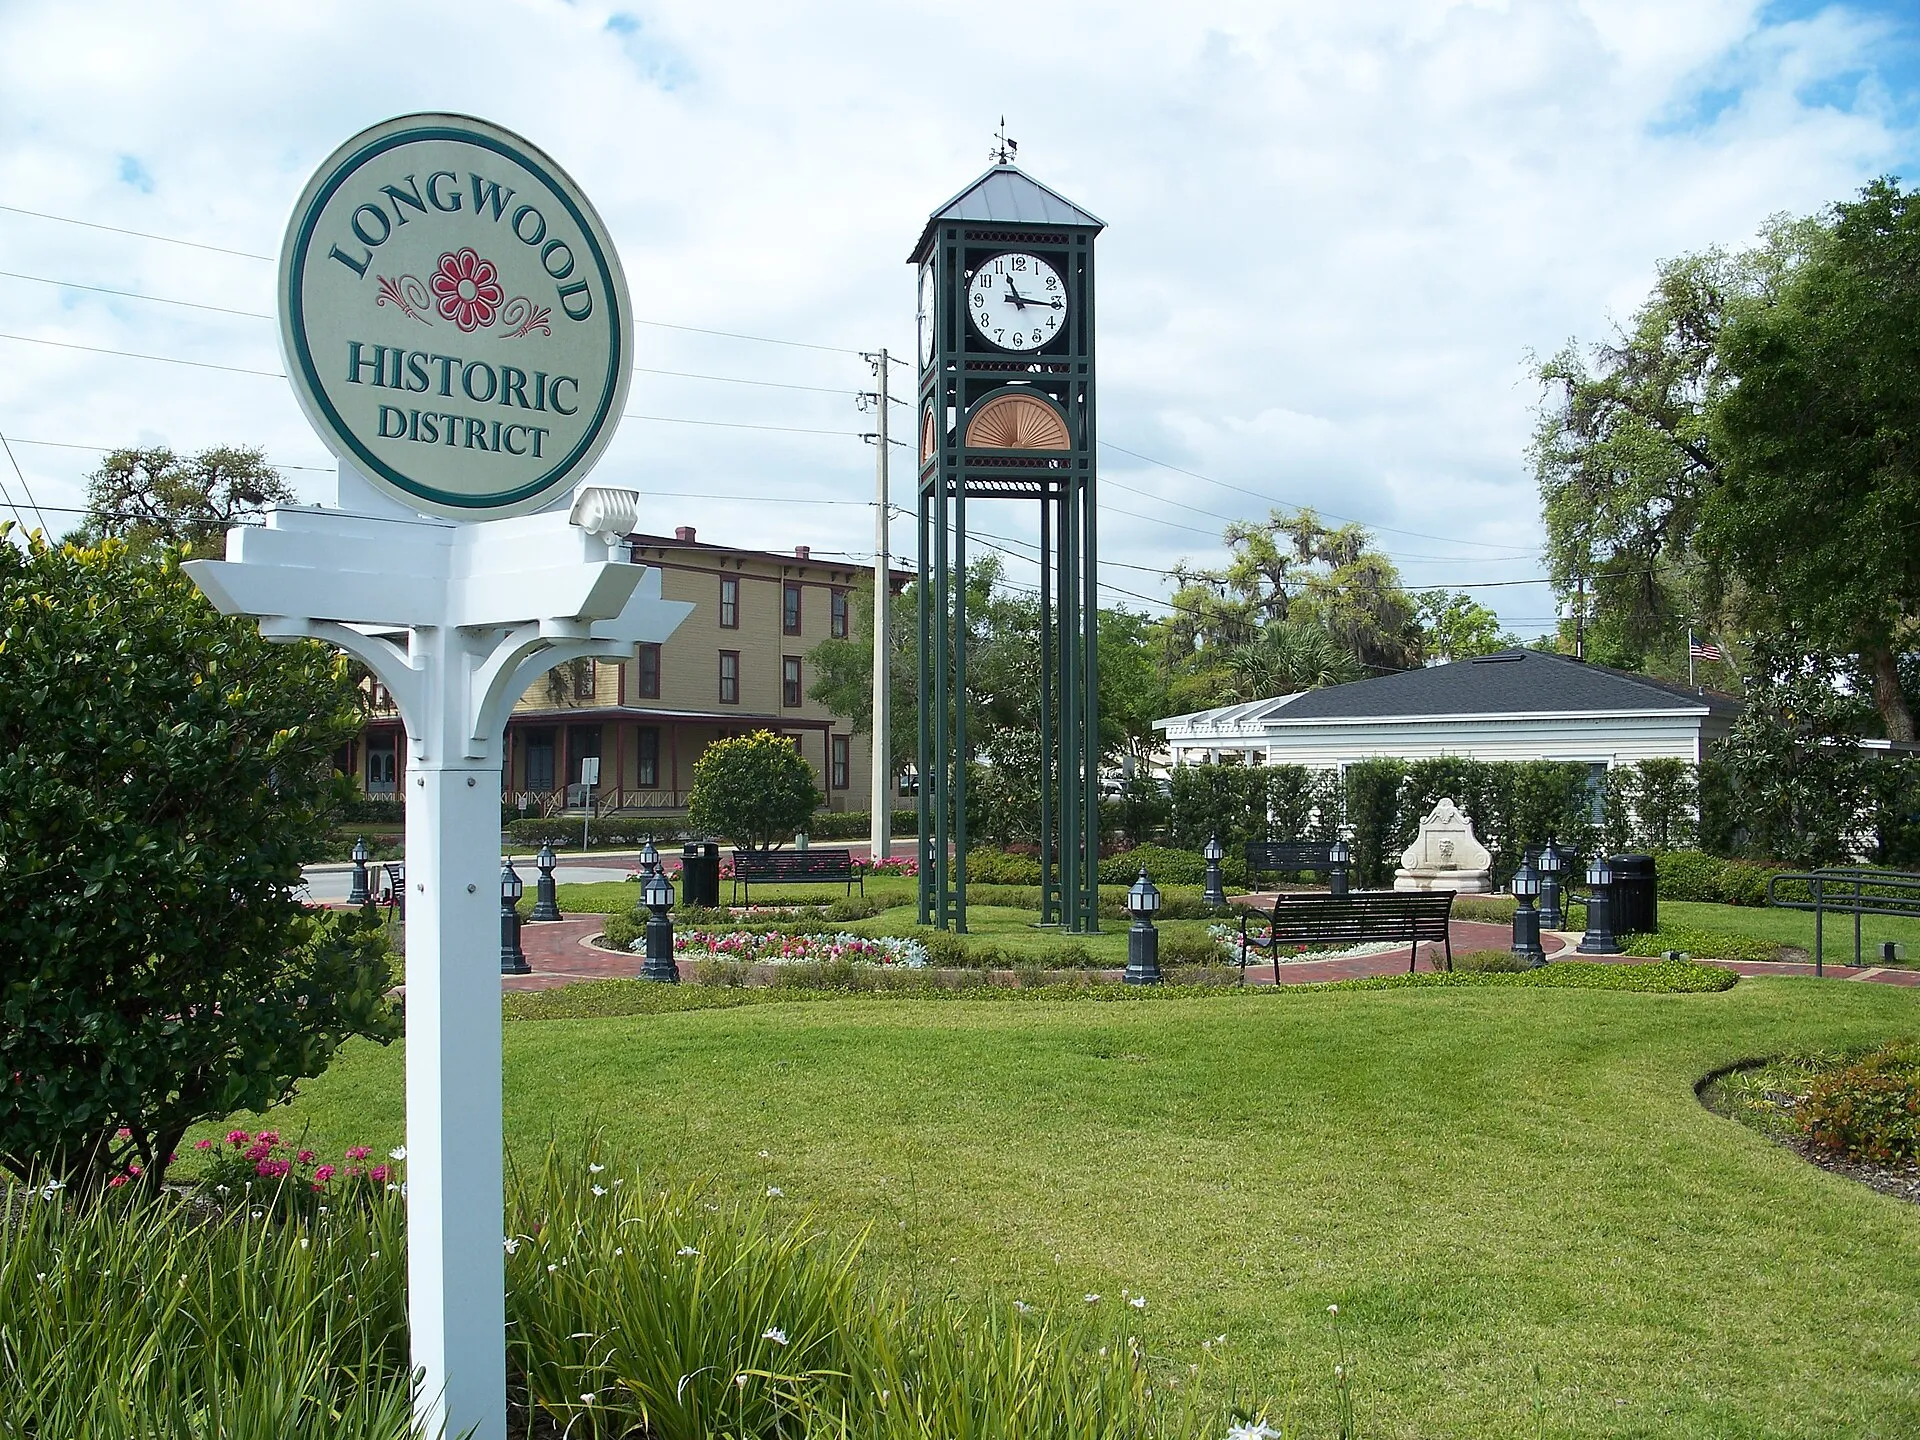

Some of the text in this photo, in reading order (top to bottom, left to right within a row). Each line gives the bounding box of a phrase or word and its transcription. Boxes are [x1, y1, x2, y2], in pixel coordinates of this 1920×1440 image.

[328, 171, 593, 322] LONGWOOD
[995, 260, 1004, 275] 11
[1011, 256, 1027, 272] 12
[1034, 261, 1039, 275] 1
[980, 273, 992, 288] 10
[1045, 276, 1057, 291] 2
[973, 293, 984, 308] 9
[1050, 295, 1062, 311] 3
[980, 313, 990, 328] 8
[1045, 315, 1056, 330] 4
[993, 328, 1005, 343] 7
[1012, 332, 1023, 347] 6
[1031, 328, 1042, 343] 5
[346, 340, 579, 416] HISTORIC
[377, 405, 549, 459] DISTRICT
